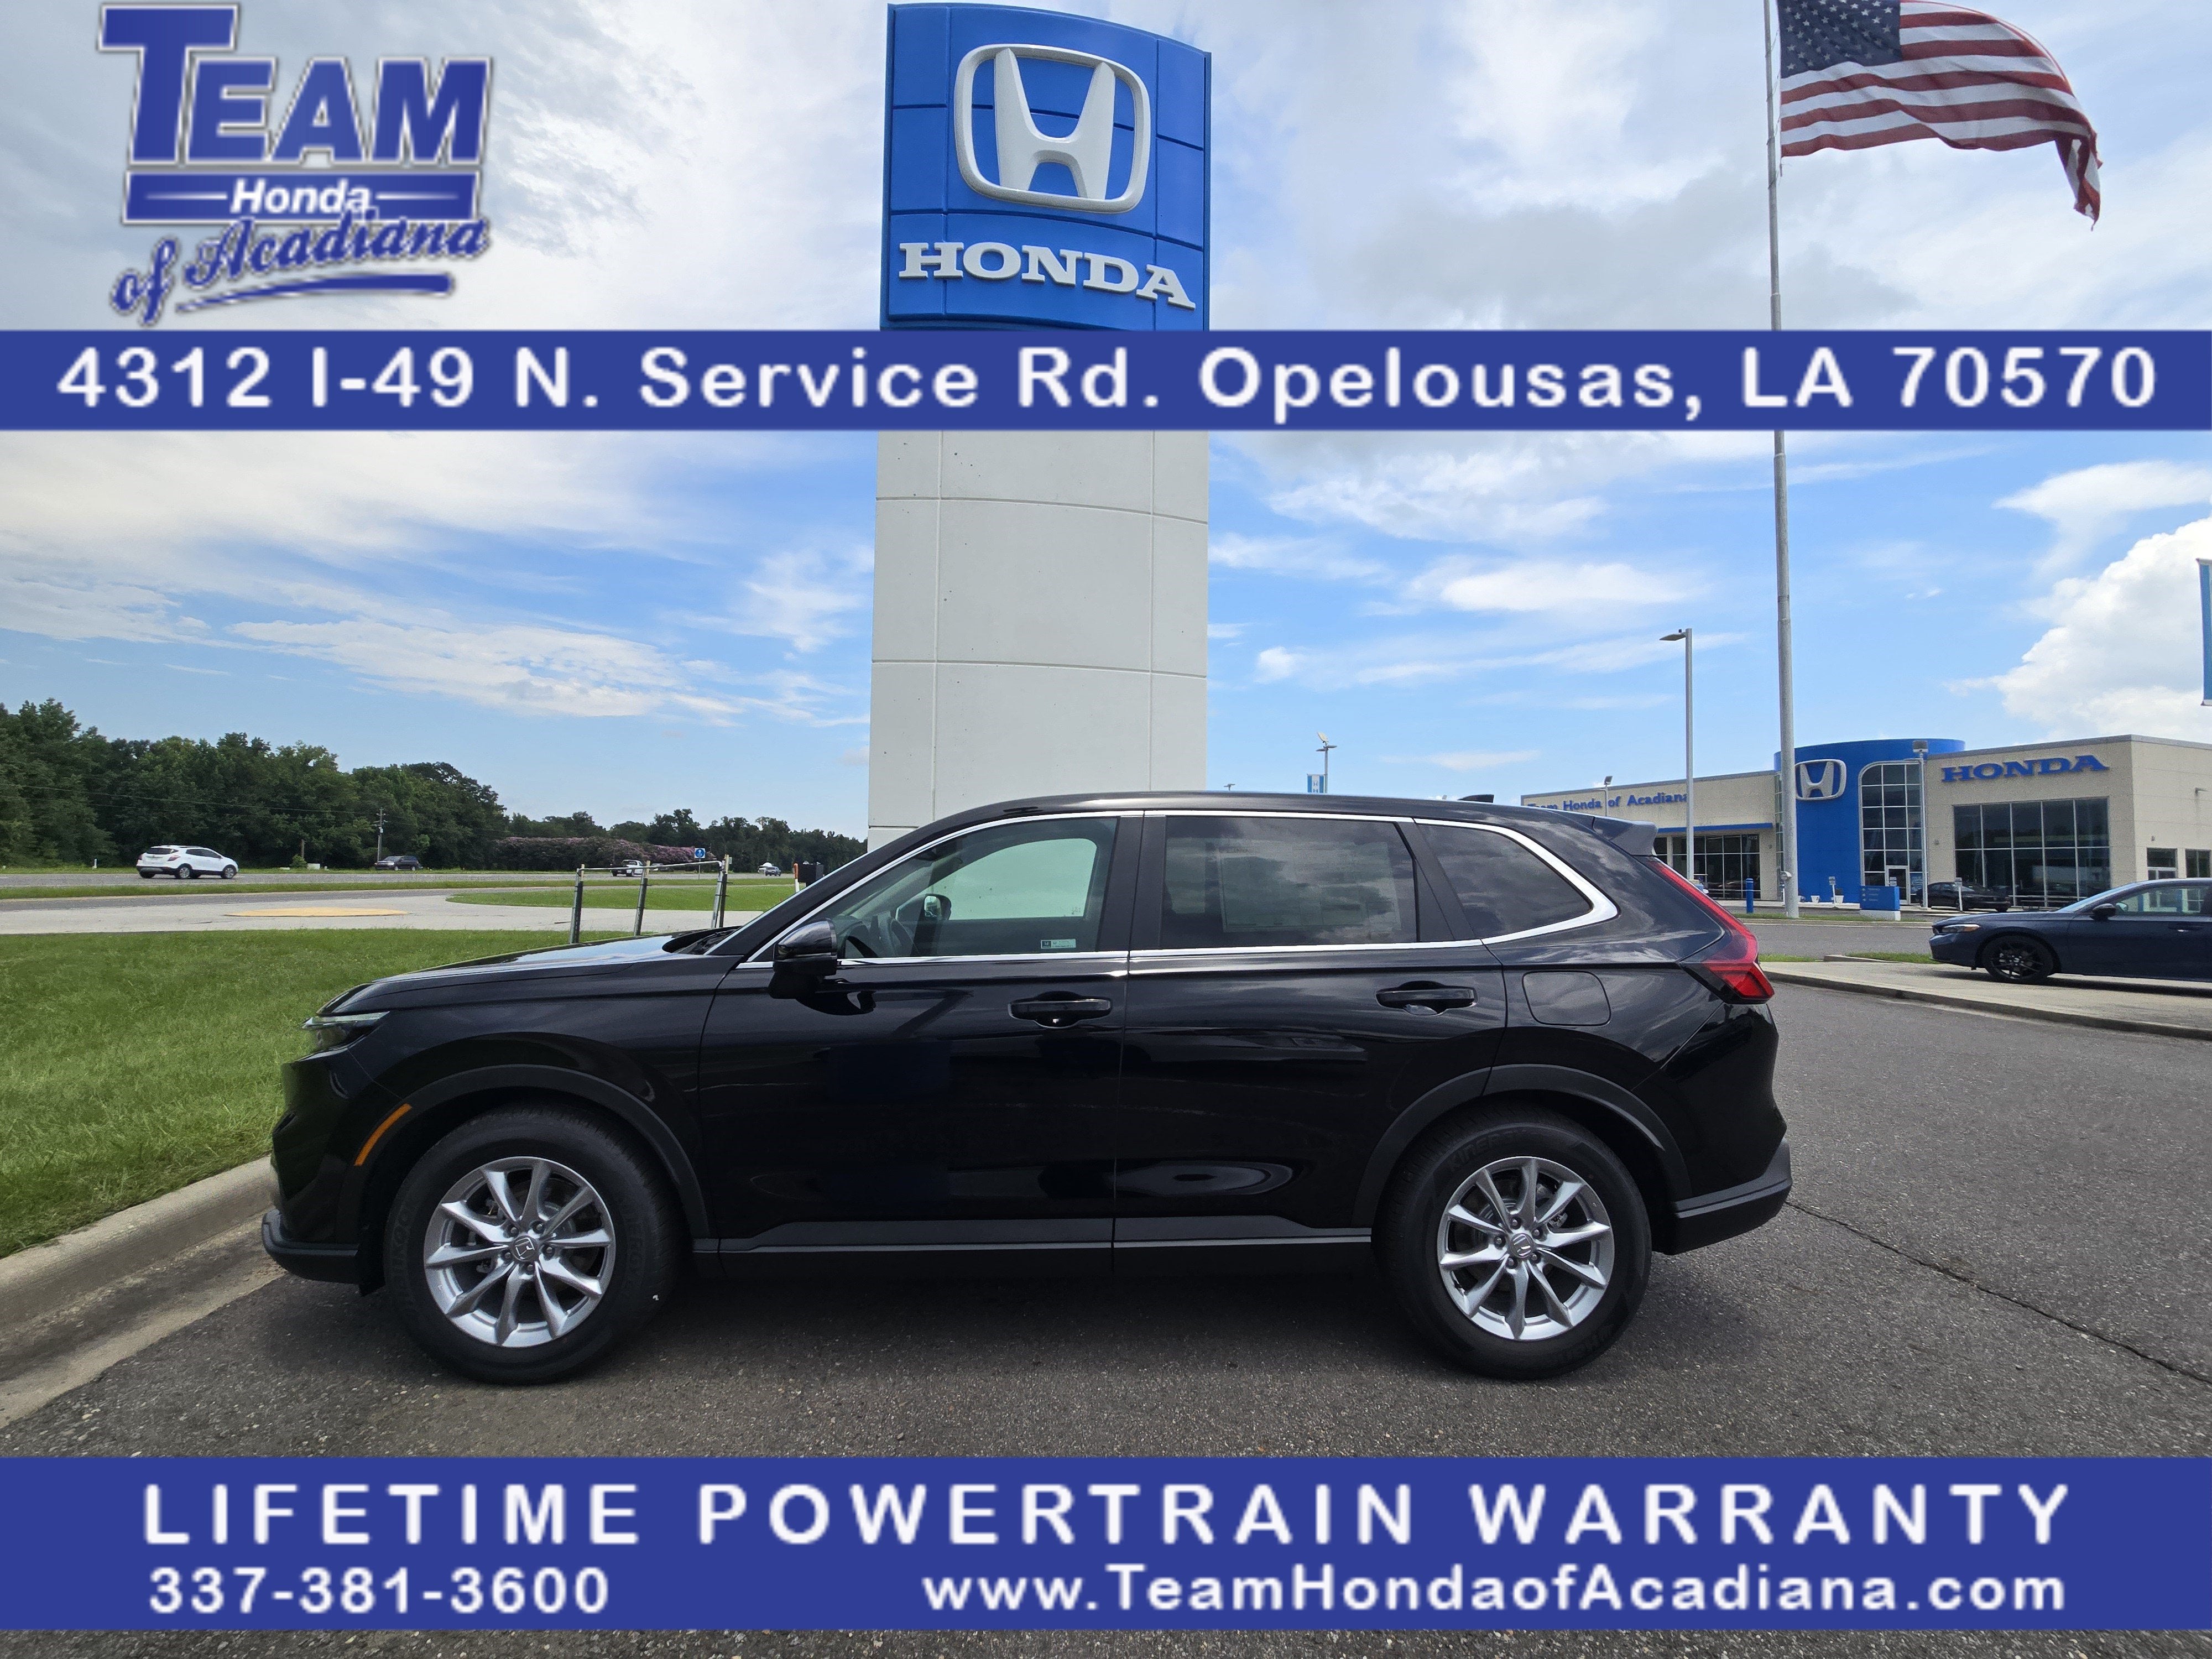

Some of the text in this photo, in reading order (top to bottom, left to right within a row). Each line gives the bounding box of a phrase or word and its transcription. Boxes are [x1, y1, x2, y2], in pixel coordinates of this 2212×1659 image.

[899, 242, 1196, 310] HONDA
[1941, 755, 2110, 782] HONDA
[1563, 798, 1602, 811] Honda
[1608, 795, 1621, 807] of
